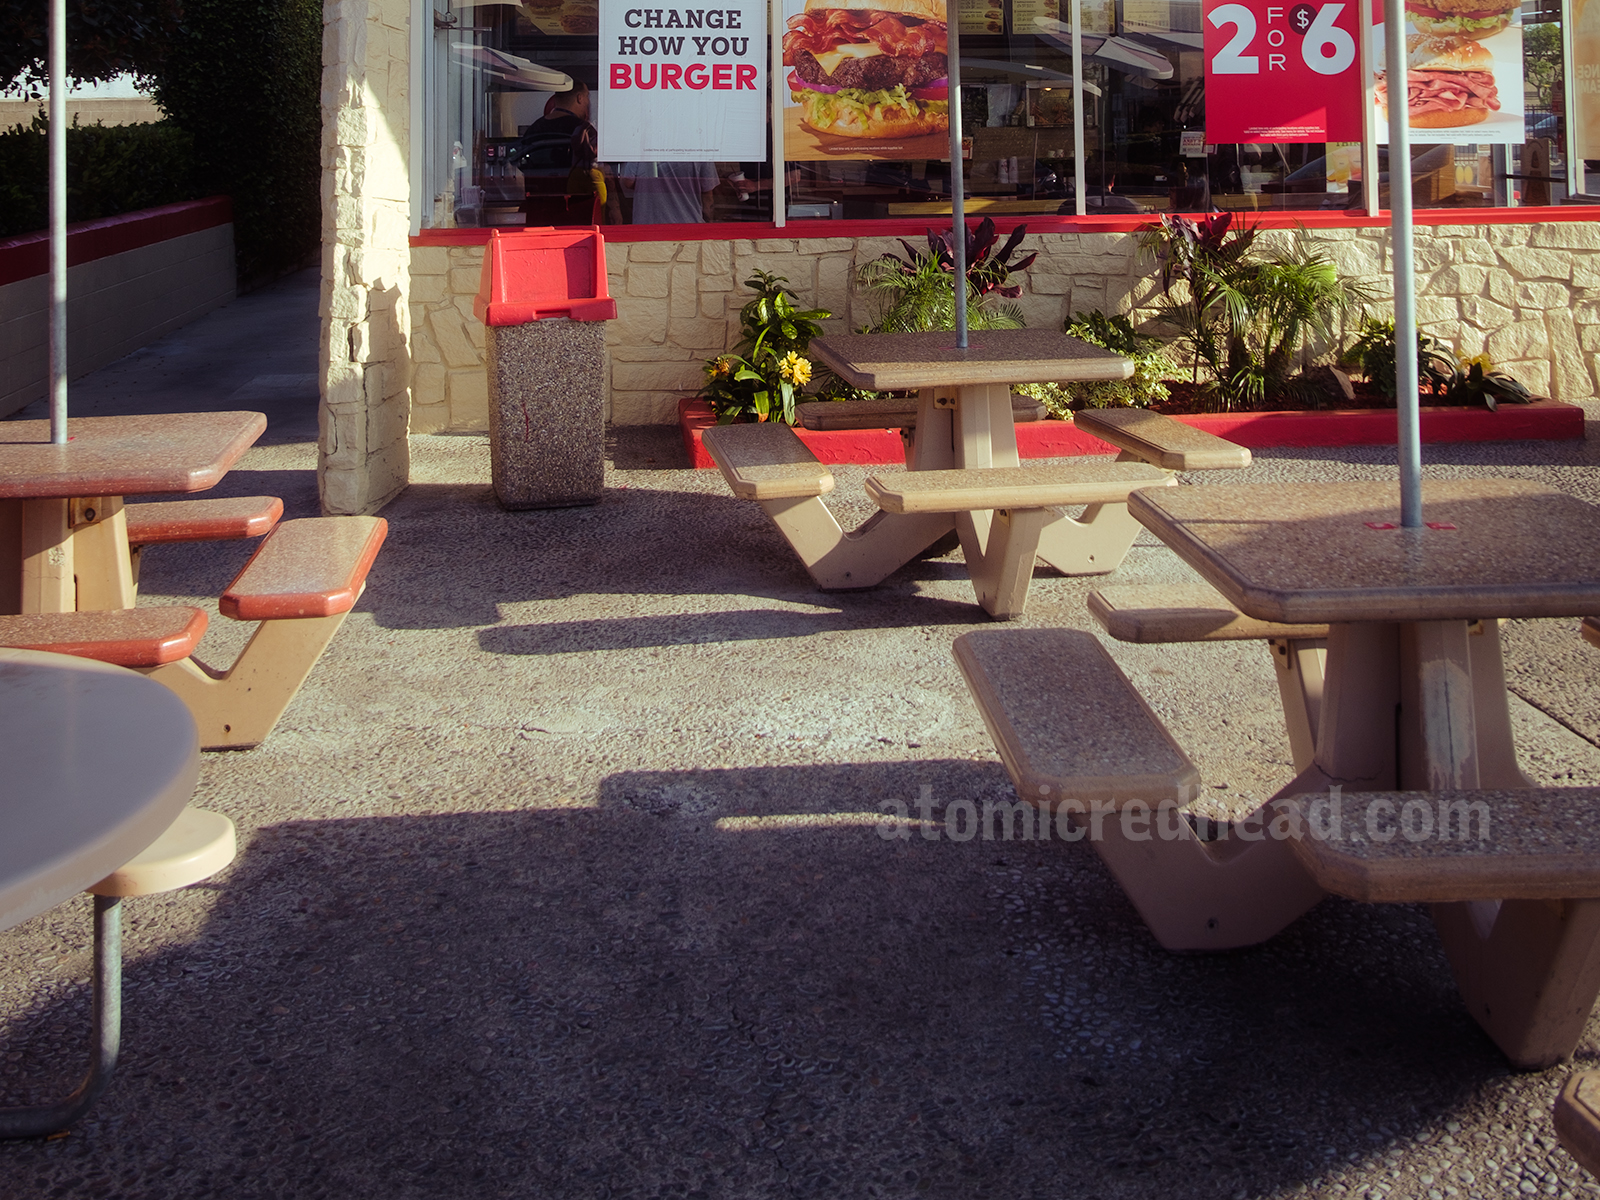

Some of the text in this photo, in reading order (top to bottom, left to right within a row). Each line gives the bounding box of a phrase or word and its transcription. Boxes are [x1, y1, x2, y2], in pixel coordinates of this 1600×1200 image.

[624, 8, 742, 29] CHANGE
[618, 35, 750, 57] HOW YOU
[1206, 3, 1259, 75] 2
[1267, 6, 1287, 71] FOR
[609, 63, 758, 90] BURGER
